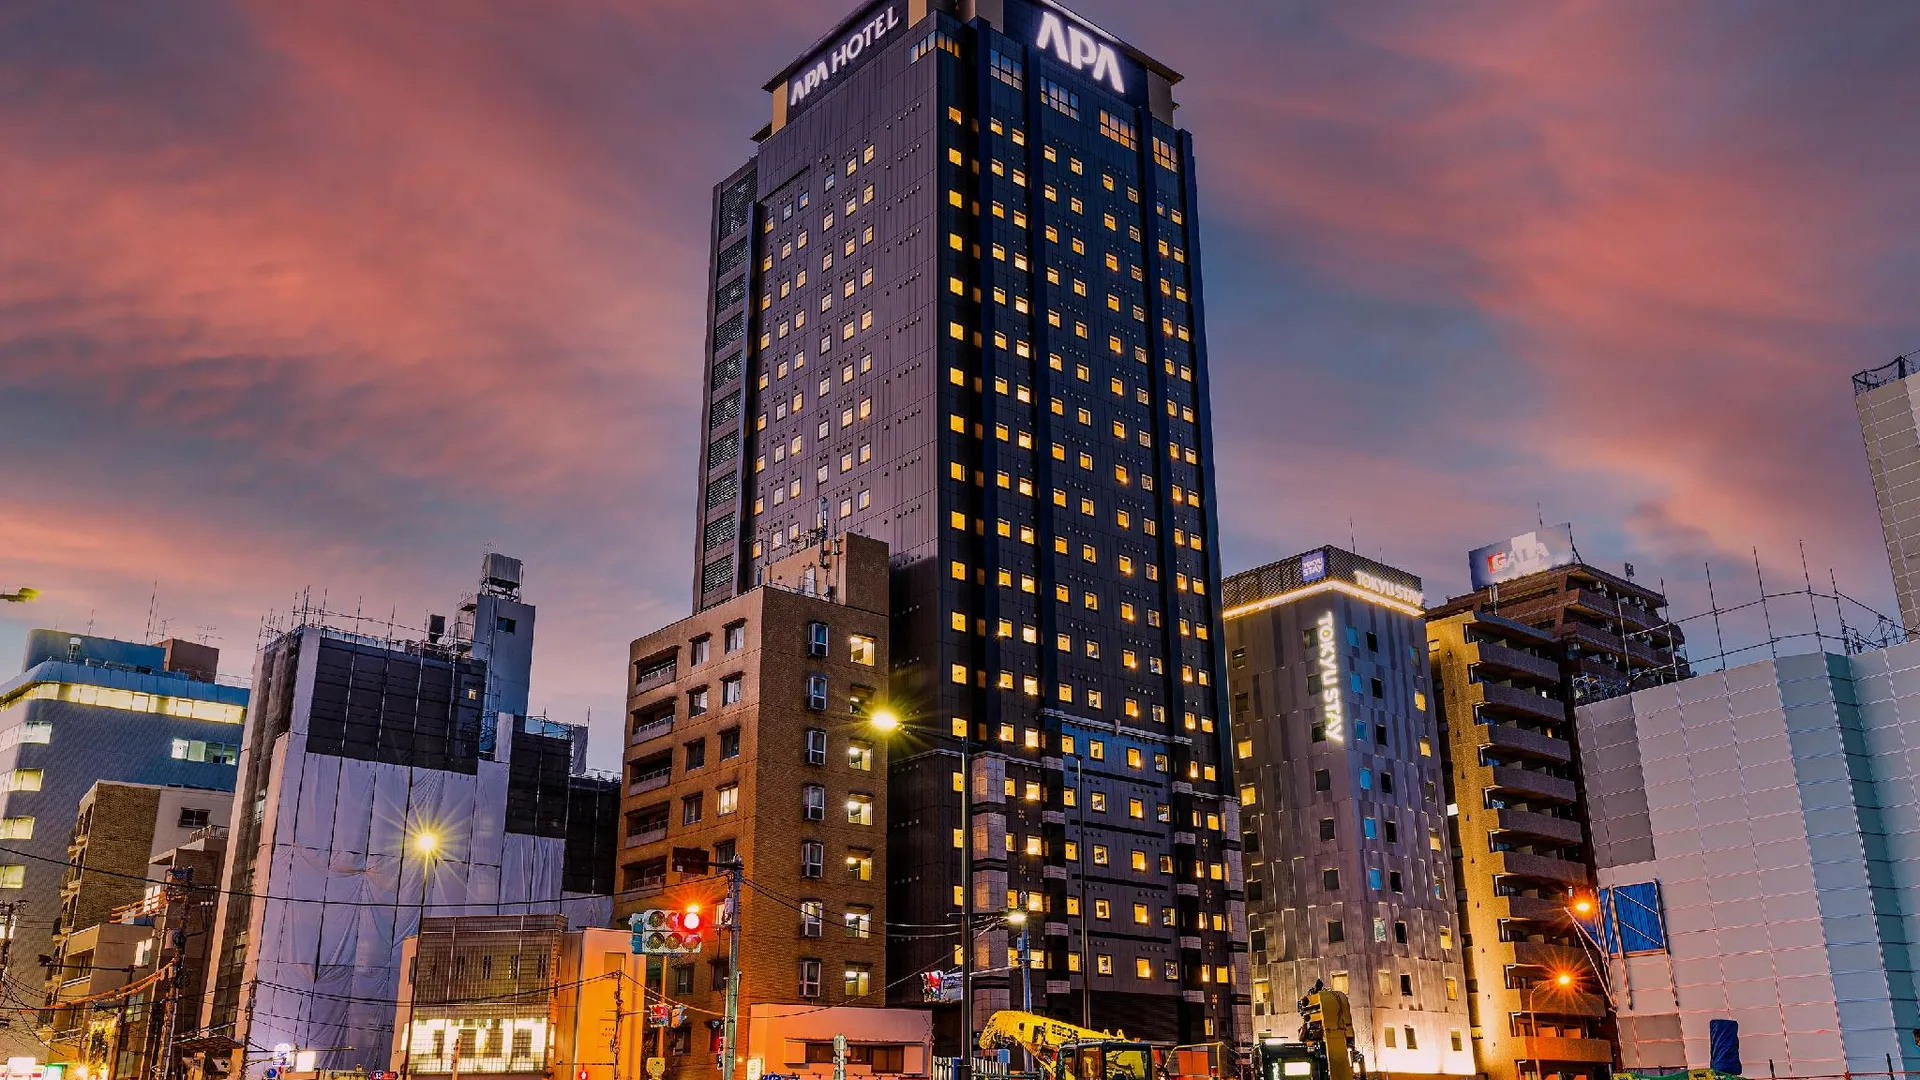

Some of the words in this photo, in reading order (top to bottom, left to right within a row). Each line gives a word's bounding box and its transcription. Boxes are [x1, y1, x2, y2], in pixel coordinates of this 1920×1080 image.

[791, 61, 829, 106] APA
[831, 6, 899, 74] HOTEL
[1036, 11, 1125, 94] APA
[1303, 563, 1324, 577] STAY
[1353, 570, 1395, 596] TOKYU
[1394, 583, 1424, 606] STAY
[1318, 610, 1338, 685] TOKYU
[1323, 687, 1344, 742] STAY
